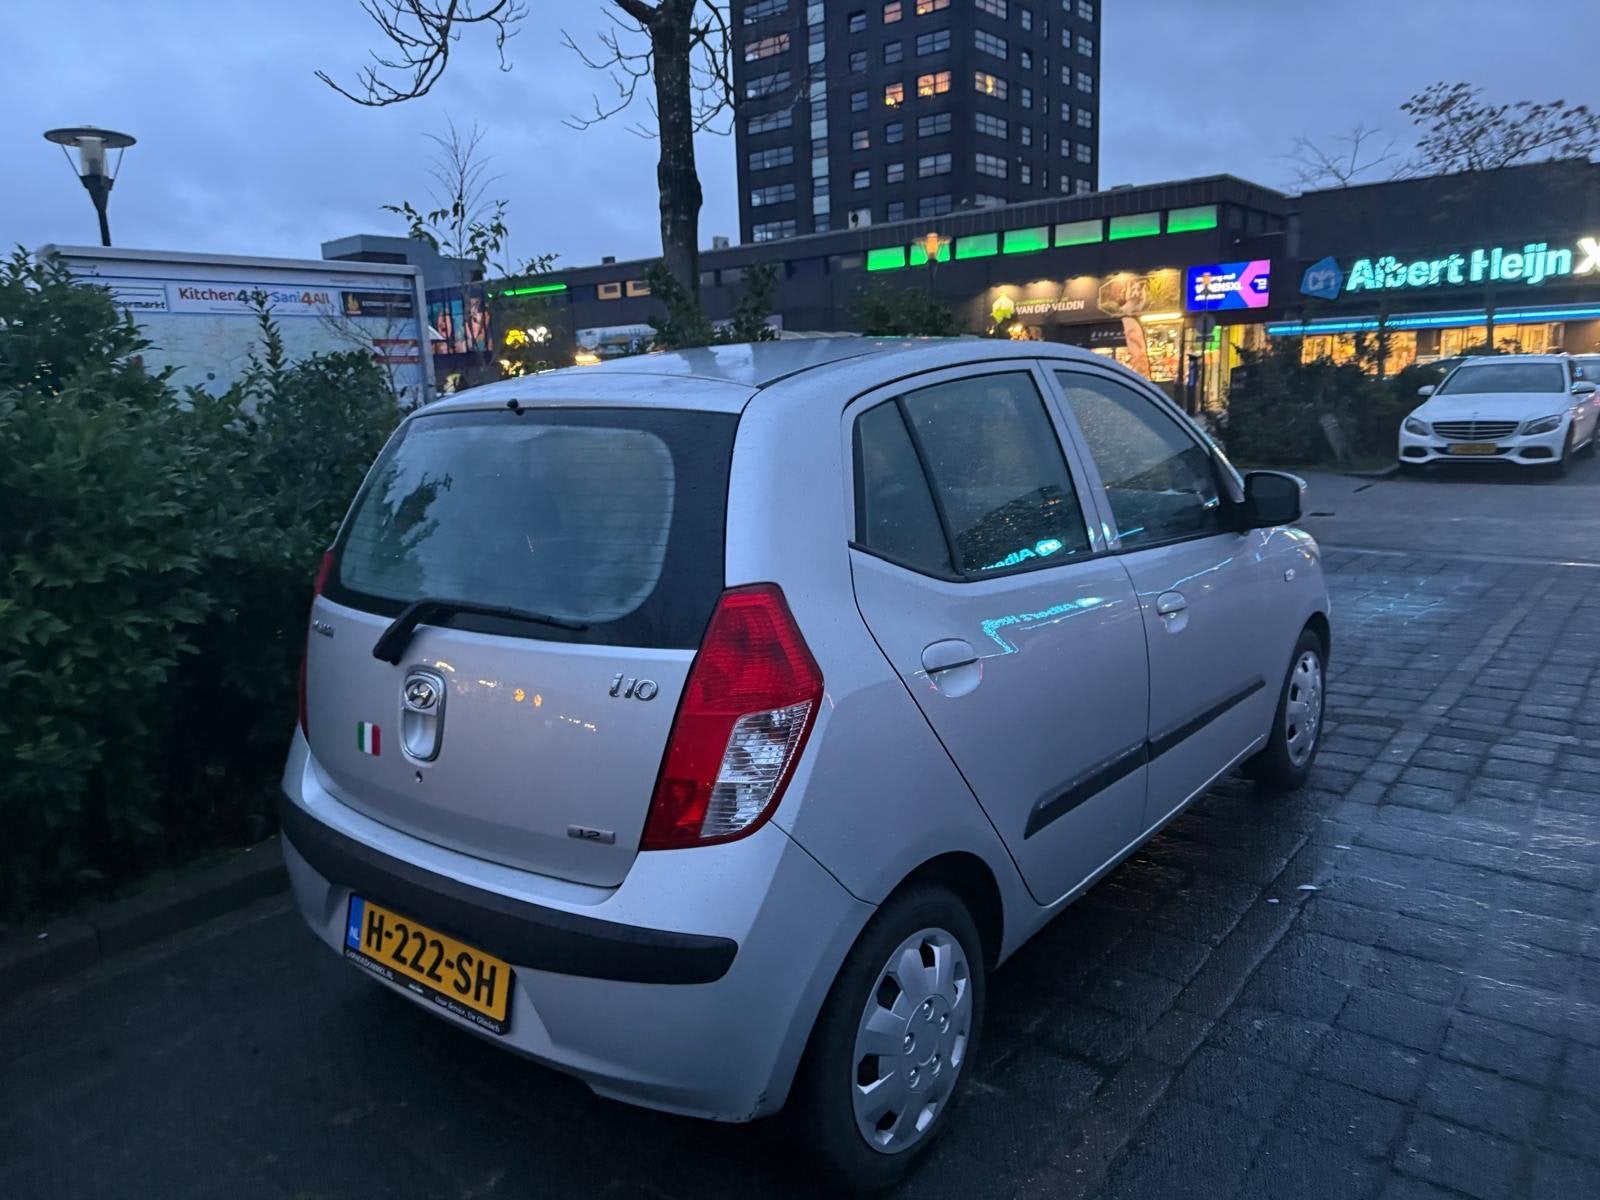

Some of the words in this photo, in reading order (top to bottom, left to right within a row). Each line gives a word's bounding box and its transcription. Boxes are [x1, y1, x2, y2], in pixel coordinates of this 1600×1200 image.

[1346, 252, 1464, 292] Albert
[1470, 242, 1572, 284] Heijn
[1194, 281, 1244, 294] WENSXL
[272, 290, 330, 306] Sani4All
[1016, 304, 1033, 315] VAN
[1051, 300, 1085, 312] VELDEN
[608, 672, 659, 702] i10
[350, 926, 360, 941] NL
[366, 910, 497, 1007] H-222-SH
